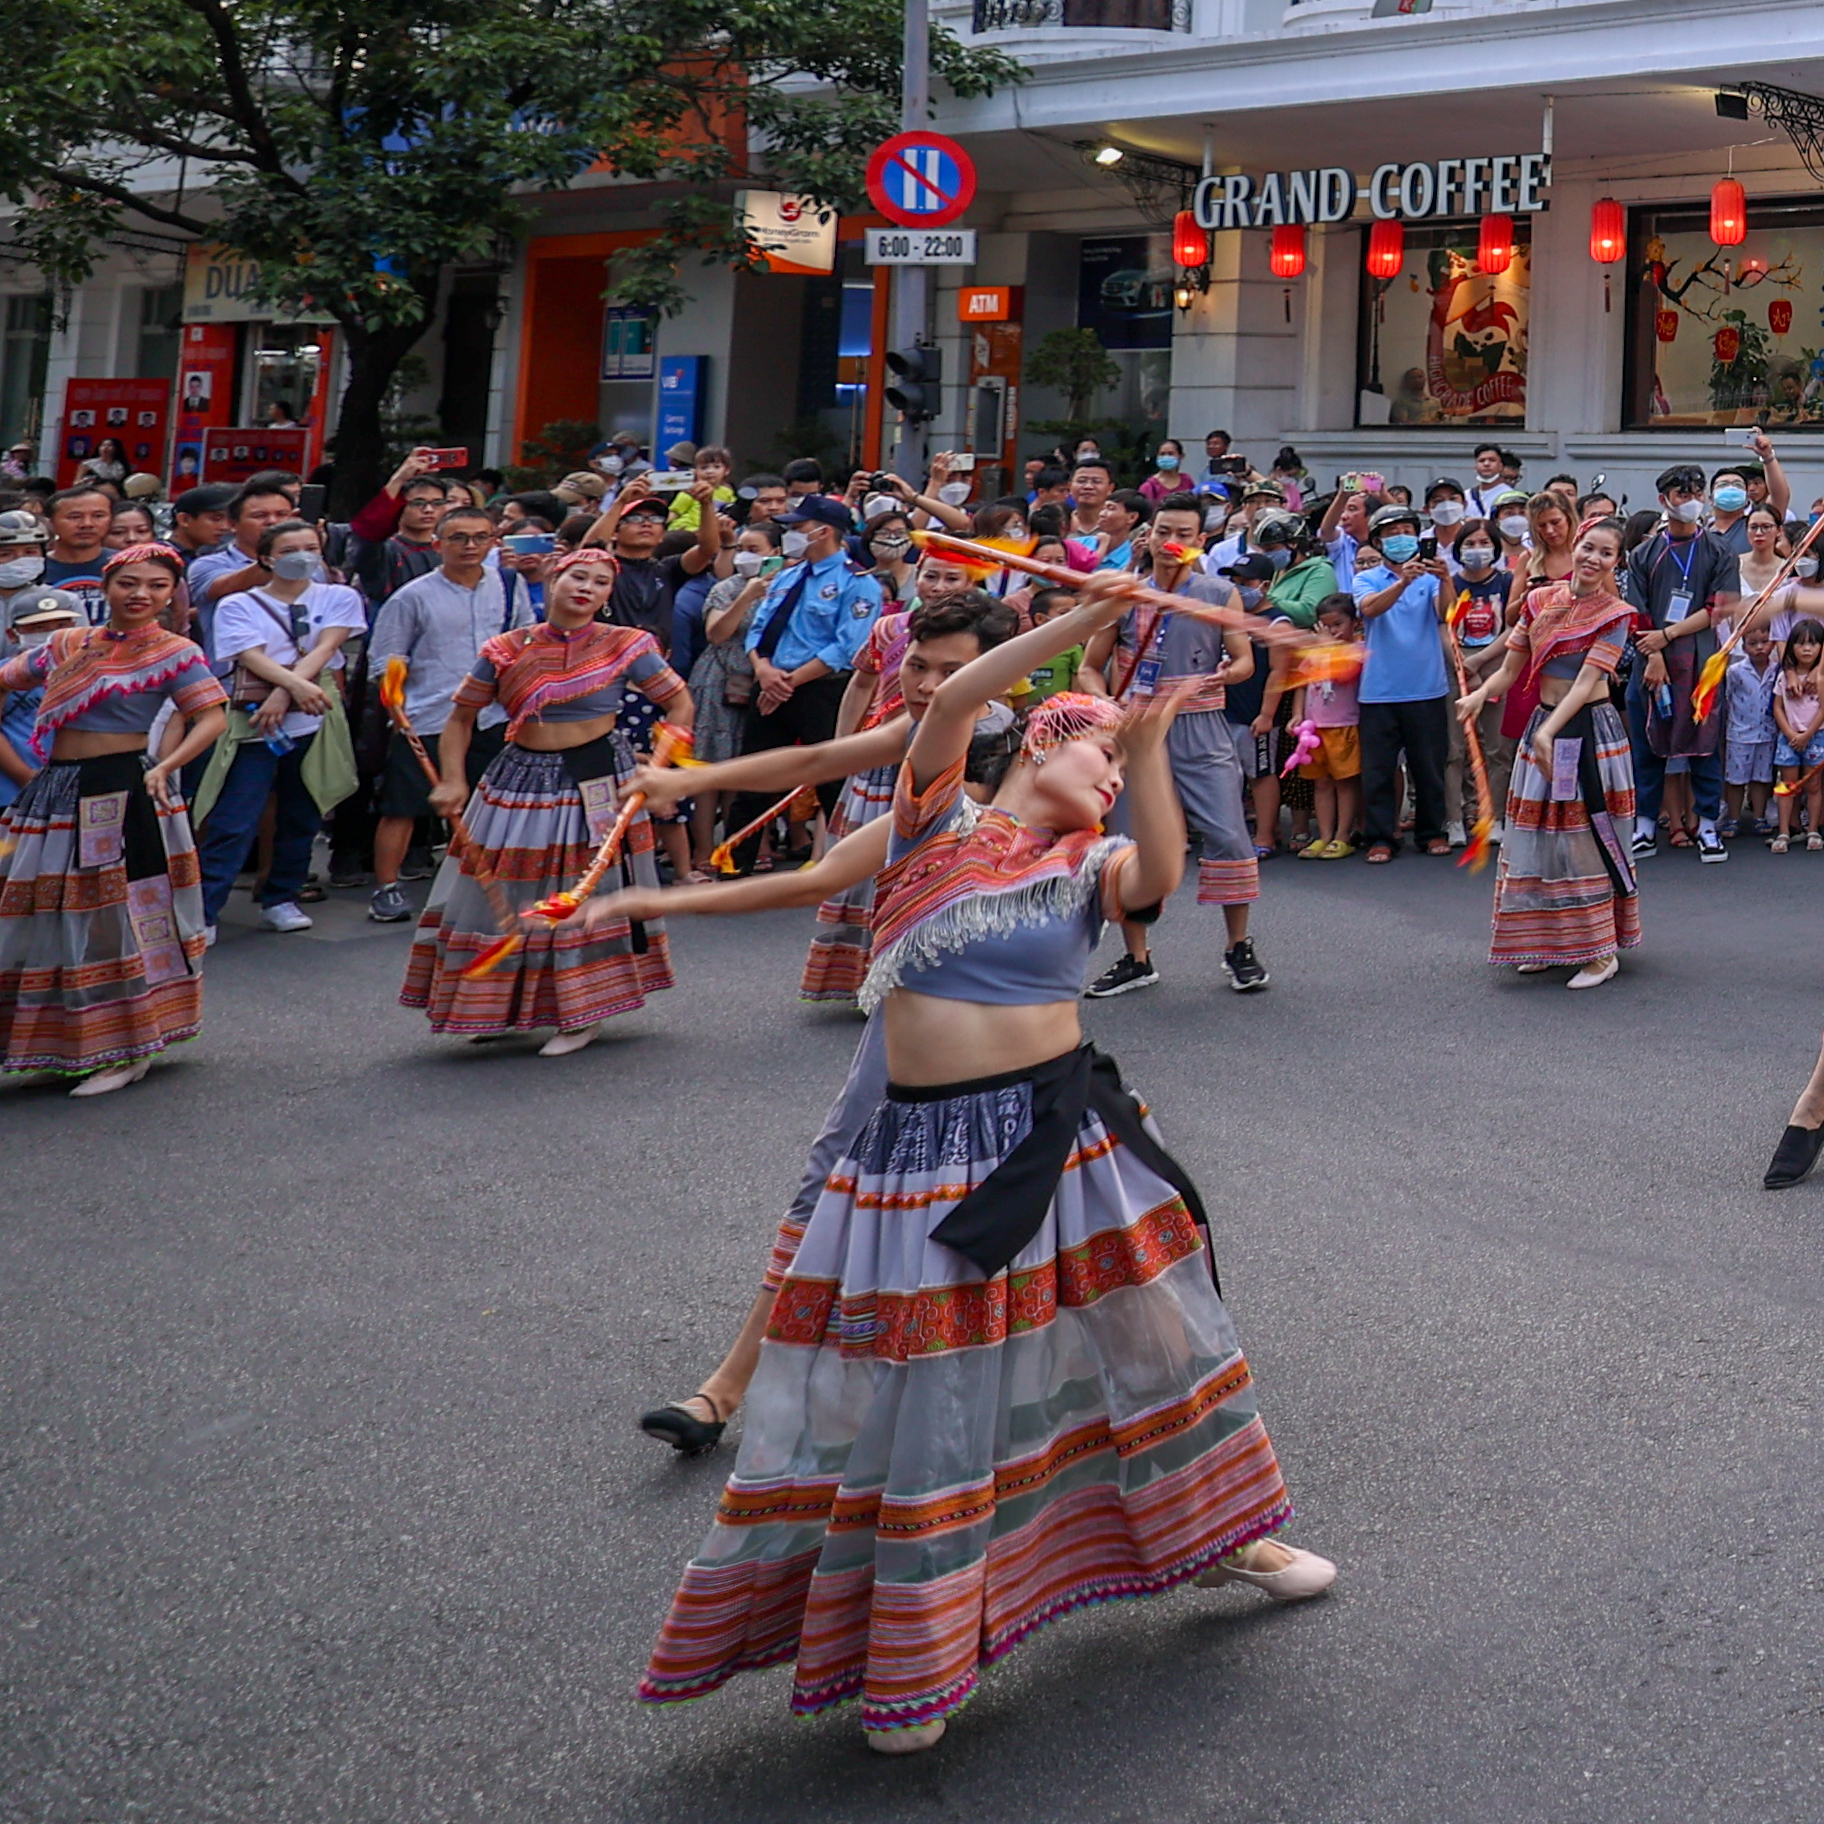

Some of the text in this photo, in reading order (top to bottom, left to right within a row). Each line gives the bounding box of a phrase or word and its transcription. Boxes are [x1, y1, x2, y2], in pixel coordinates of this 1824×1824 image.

[1193, 153, 1551, 229] GRAND COFFEE
[878, 236, 909, 257] 6:00
[924, 236, 963, 257] 22:00
[968, 293, 999, 314] ATM
[1475, 376, 1513, 406] COFFEE
